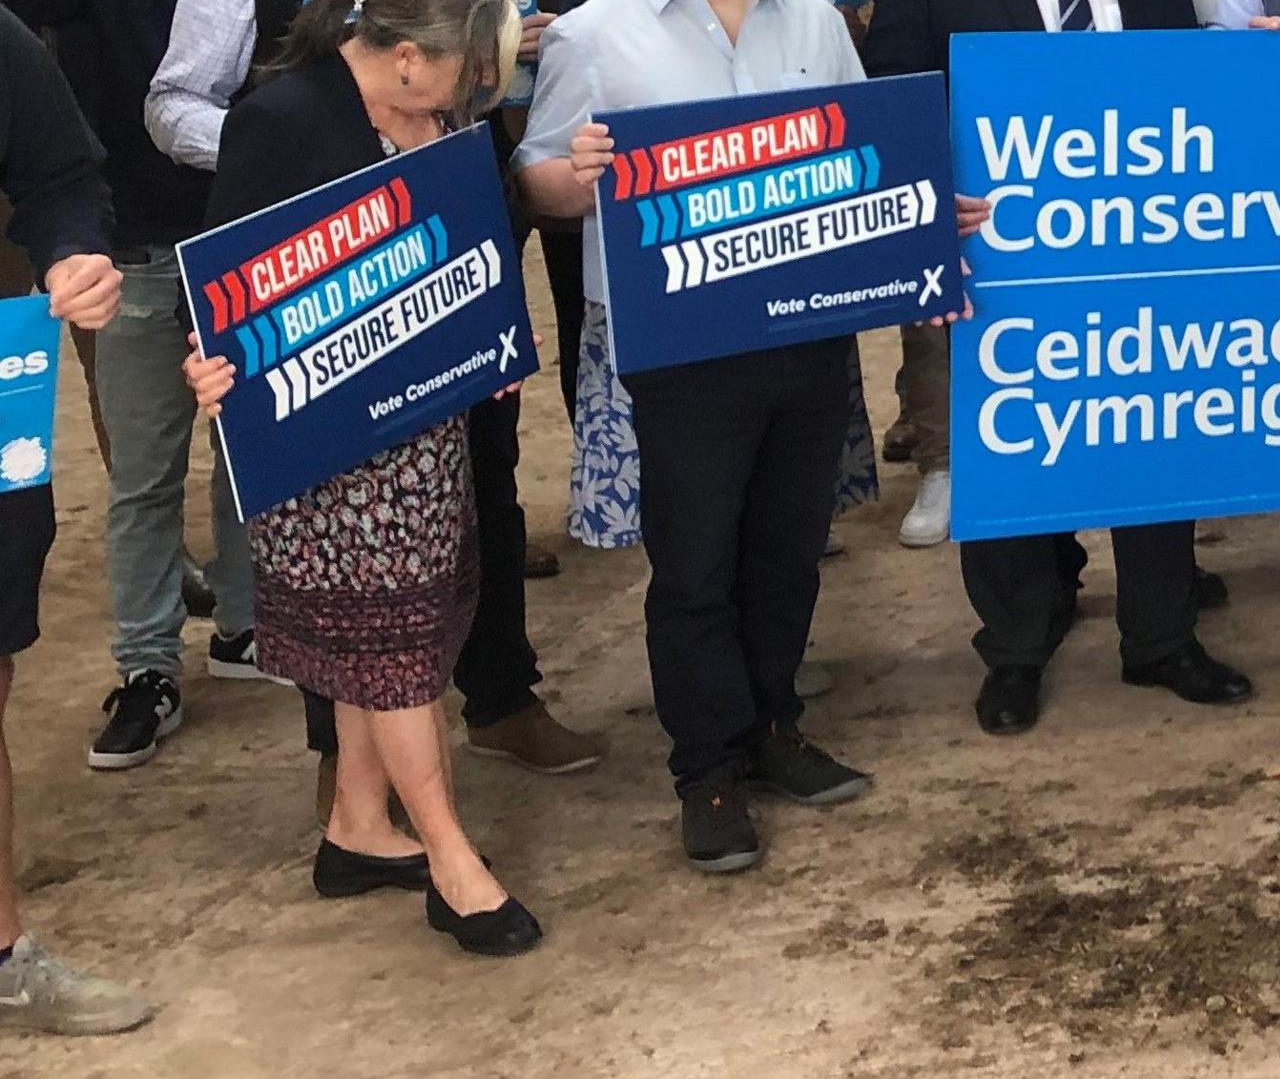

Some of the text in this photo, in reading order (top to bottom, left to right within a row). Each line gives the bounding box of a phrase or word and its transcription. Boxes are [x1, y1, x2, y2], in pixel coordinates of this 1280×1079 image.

[662, 114, 819, 183] CLEAR PLAN
[976, 107, 1215, 181] Welsh
[688, 156, 852, 229] BOLD ACTION
[250, 194, 390, 301] CLEAR PLAN
[714, 192, 912, 273] SECURE FUTURE
[281, 231, 427, 346] BOLD ACTION
[311, 255, 482, 387] SECURE FUTURE
[767, 298, 806, 317] Vote
[809, 279, 918, 310] Conservative
[368, 395, 404, 420] Vote
[405, 347, 497, 403] Conservative
